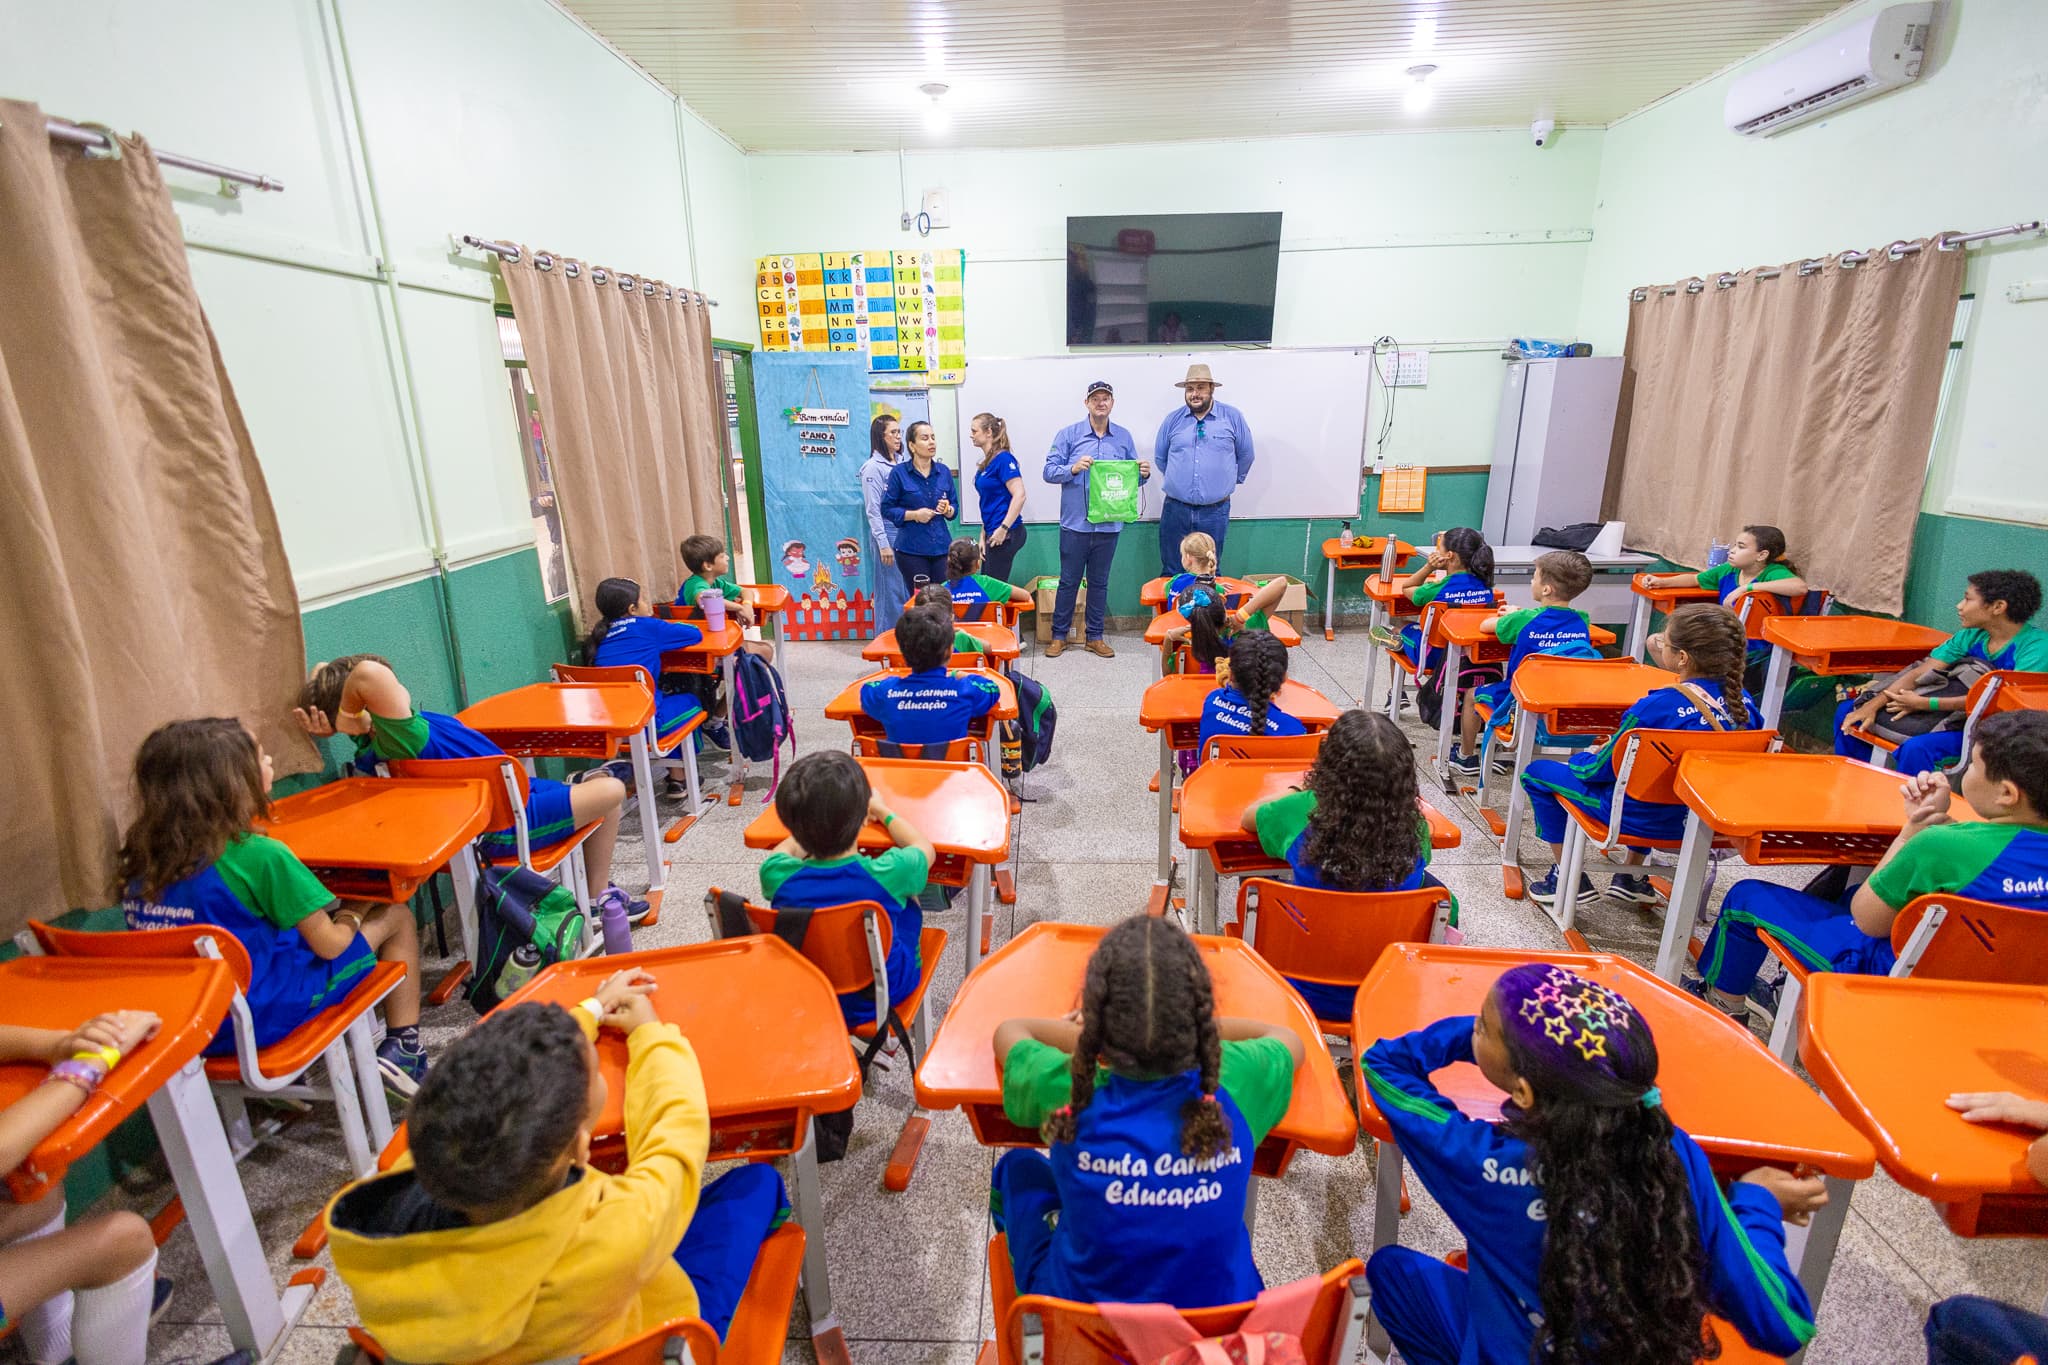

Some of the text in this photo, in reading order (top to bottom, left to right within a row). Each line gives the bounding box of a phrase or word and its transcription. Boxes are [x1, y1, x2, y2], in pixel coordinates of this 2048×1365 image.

[828, 256, 833, 266] J
[897, 255, 903, 265] S
[760, 262, 766, 271] A
[760, 275, 767, 285] B
[828, 272, 836, 282] K
[898, 271, 904, 281] T
[760, 289, 769, 300] C
[831, 287, 837, 297] L
[899, 286, 905, 296] U
[762, 305, 771, 315] D
[829, 302, 840, 312] M
[900, 302, 907, 311] V
[766, 319, 771, 329] E
[832, 317, 839, 327] N
[898, 315, 909, 325] W
[767, 334, 773, 343] F
[832, 331, 841, 341] O
[901, 330, 909, 340] X
[902, 344, 909, 354] Y
[903, 359, 909, 369] Z
[810, 432, 828, 440] ANO
[1528, 631, 1587, 639] Santa Carmem
[887, 689, 914, 698] Santa
[897, 699, 947, 711] Educação
[1212, 696, 1236, 712] Santa
[143, 902, 195, 920] Carmem
[1077, 1151, 1148, 1177] Santa
[1105, 1177, 1223, 1209] Educação
